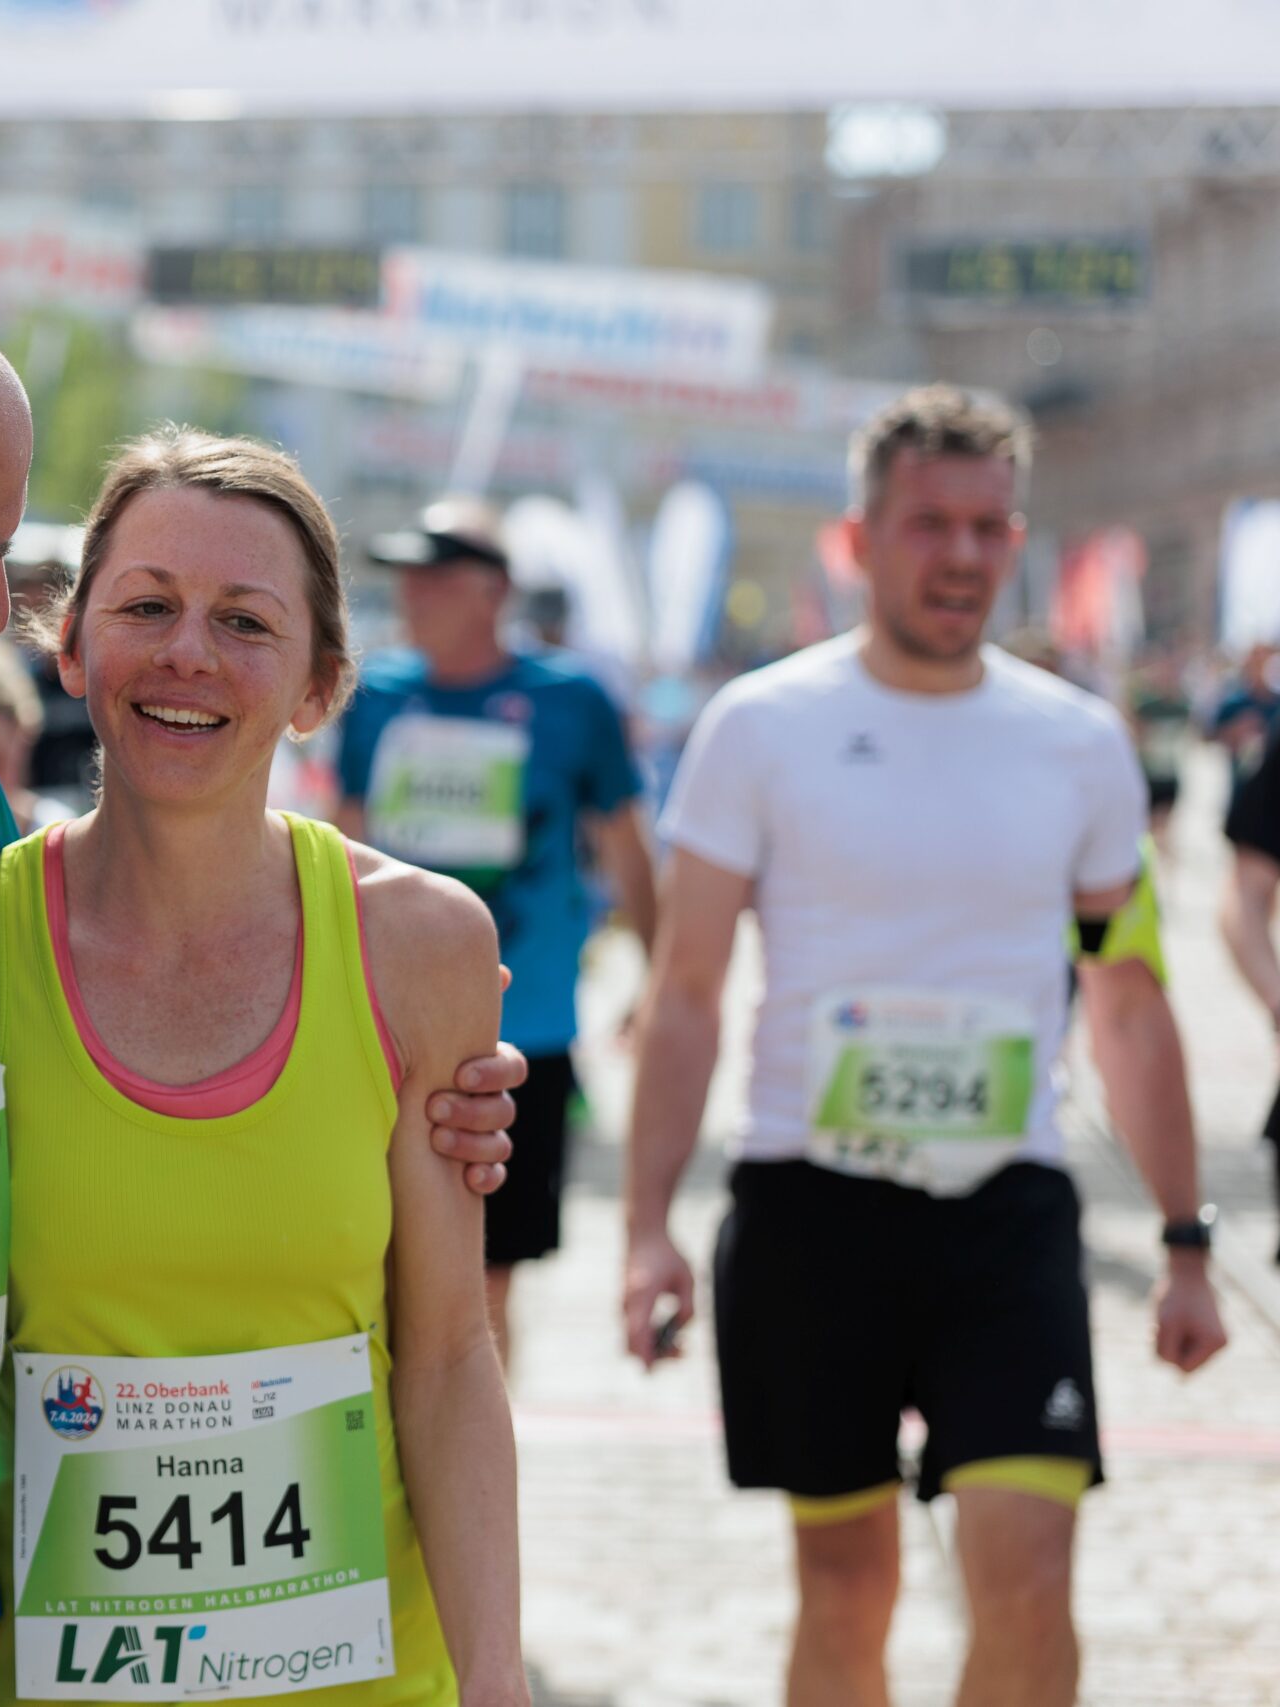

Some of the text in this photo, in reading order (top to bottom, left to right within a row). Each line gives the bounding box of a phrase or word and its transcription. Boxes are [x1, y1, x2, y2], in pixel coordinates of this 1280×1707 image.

[857, 1065, 989, 1116] 5294
[115, 1380, 230, 1399] 22. Oberbank
[49, 1409, 98, 1426] 7.4.2024
[116, 1399, 232, 1415] LINZ DONAU
[116, 1415, 232, 1431] MARATHON
[156, 1455, 244, 1478] Hanna
[93, 1482, 311, 1570] 5414
[45, 1567, 360, 1614] LAT NITROGEN HALBMARATHON
[55, 1623, 354, 1685] LAT Nitrogen
